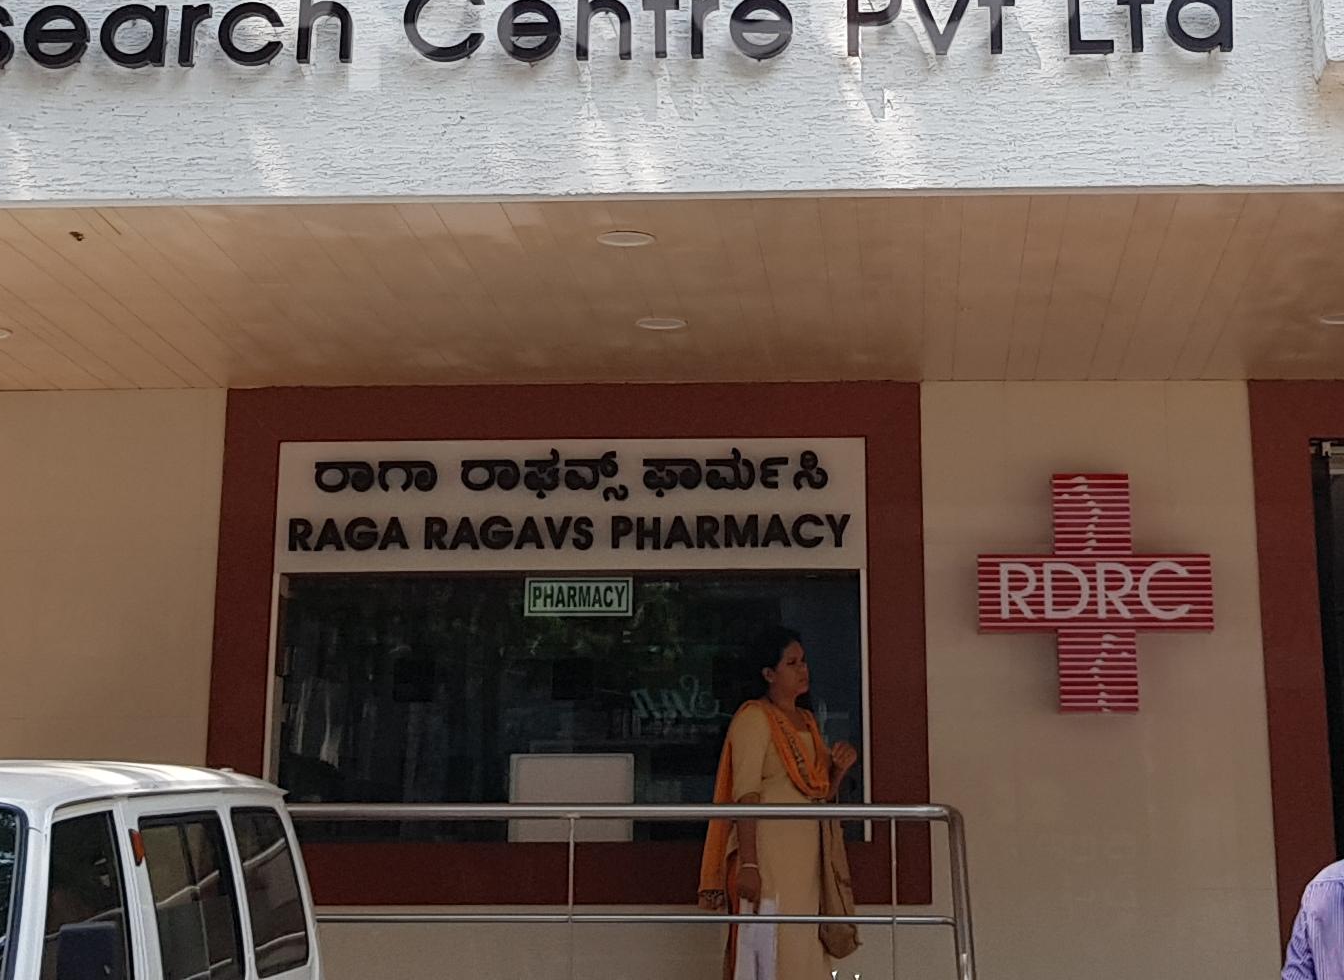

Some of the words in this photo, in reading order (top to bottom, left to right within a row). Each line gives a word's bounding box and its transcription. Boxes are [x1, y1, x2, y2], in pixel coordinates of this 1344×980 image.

[314, 460, 439, 494] ರಾಗಾ
[287, 516, 411, 552] RAGA
[423, 515, 595, 551] RAGAVS
[610, 513, 851, 551] PHARMACY
[531, 584, 626, 609] PHARMACY
[999, 561, 1194, 620] RDRC
